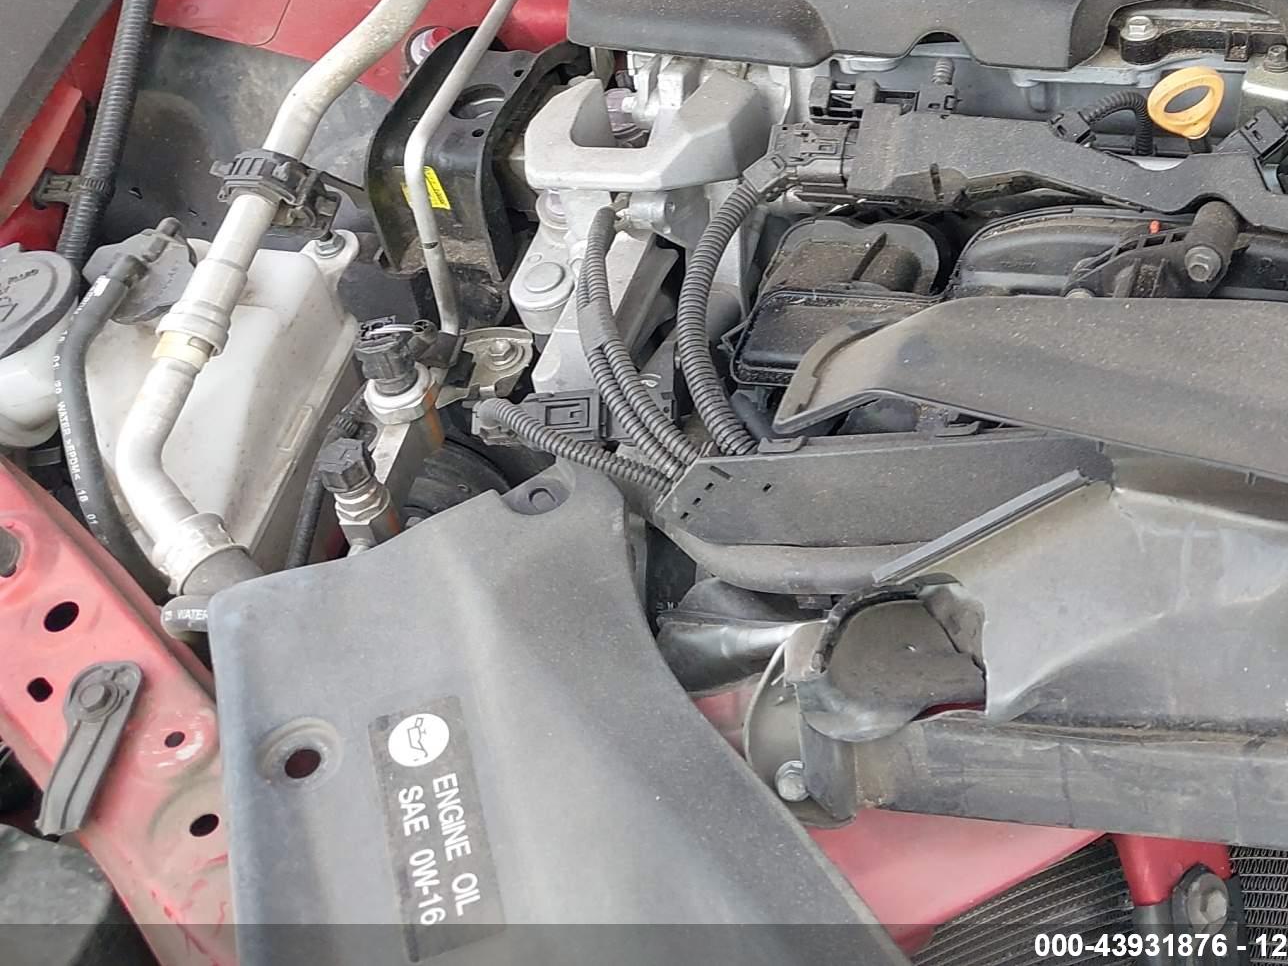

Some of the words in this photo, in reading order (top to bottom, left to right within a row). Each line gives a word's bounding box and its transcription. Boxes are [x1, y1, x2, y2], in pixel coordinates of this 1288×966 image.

[57, 402, 72, 436] WATER
[398, 785, 430, 837] SAE
[433, 773, 471, 862] ENGINE
[408, 848, 446, 926] 0W-16
[451, 872, 481, 917] OIL
